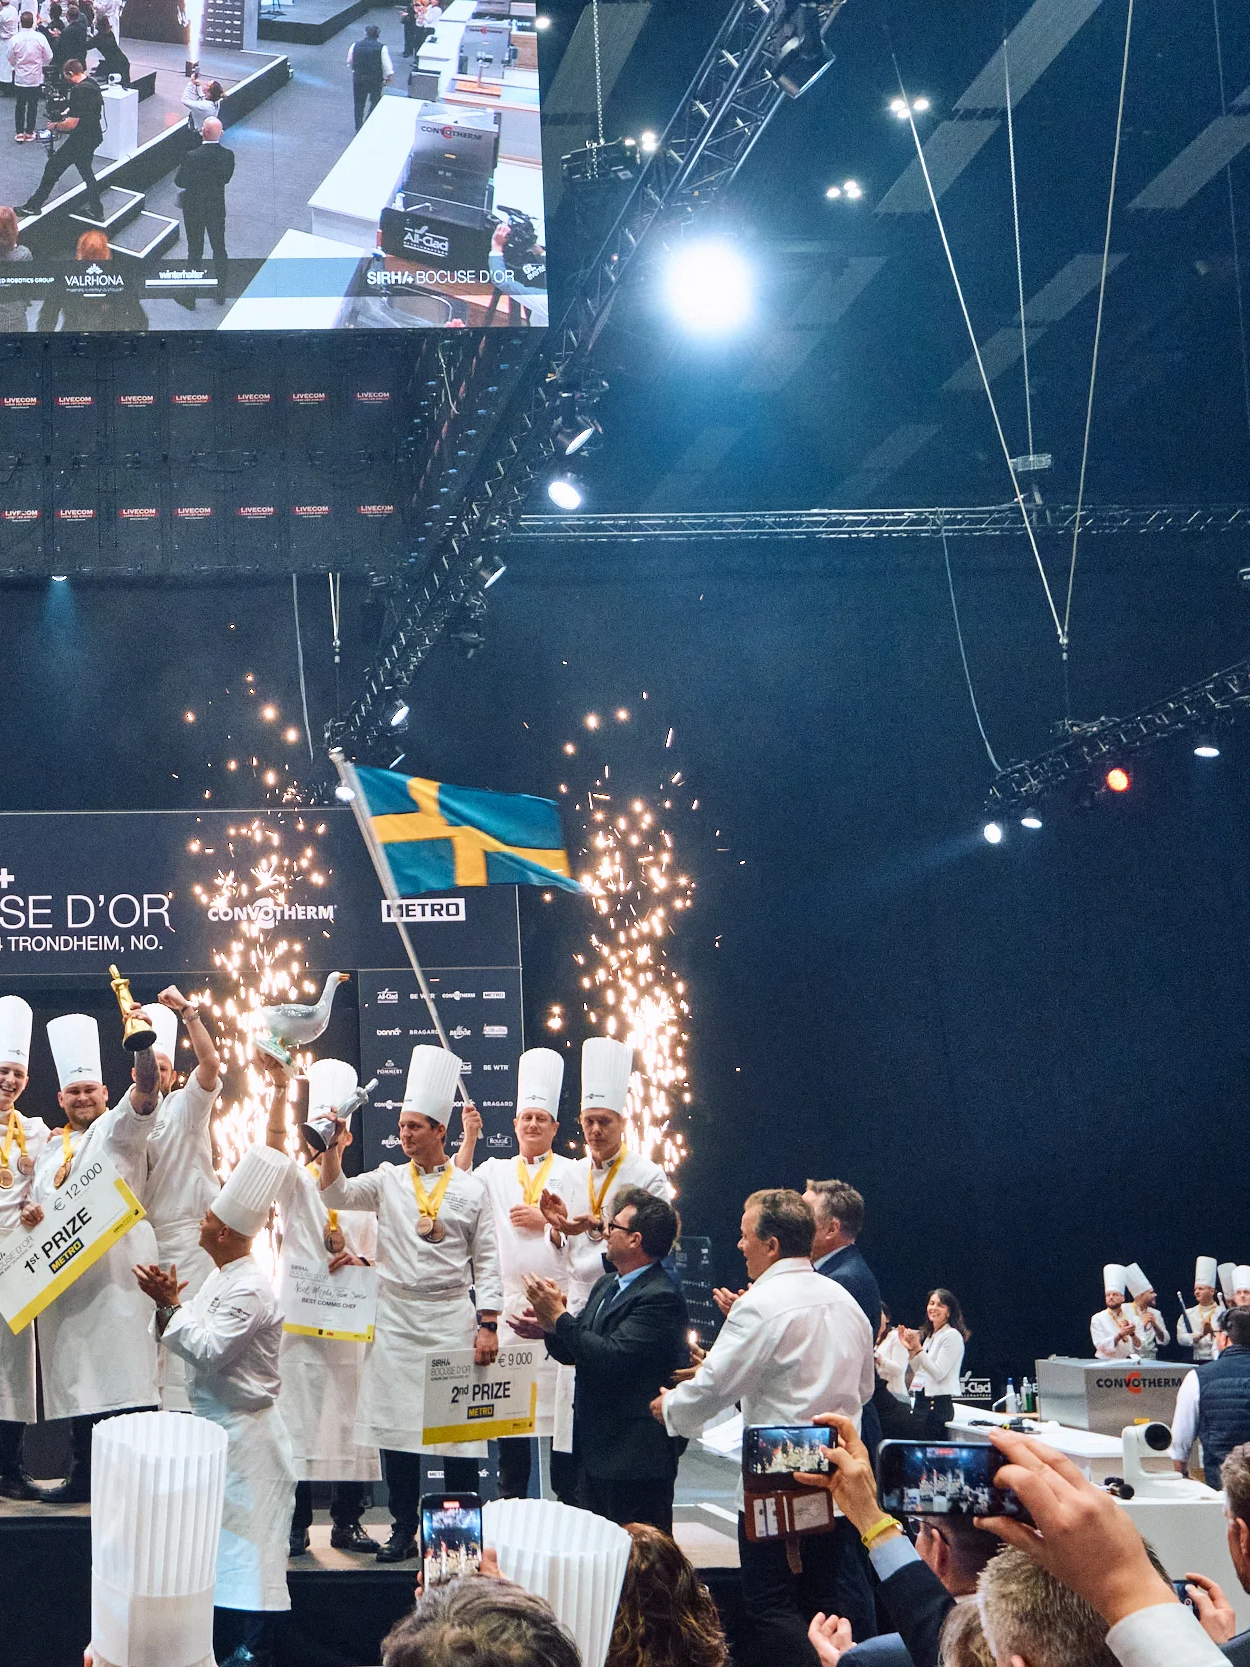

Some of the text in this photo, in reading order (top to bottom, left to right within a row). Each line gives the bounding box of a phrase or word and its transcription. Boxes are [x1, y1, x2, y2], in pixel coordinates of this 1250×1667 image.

[421, 126, 482, 140] CONVOTHERM
[65, 274, 124, 286] VALRHONA
[416, 271, 476, 284] BOCUSE
[480, 270, 515, 284] D'OR
[67, 893, 171, 928] D'OR
[207, 904, 334, 922] CONVOTHERM
[7, 935, 125, 953] TRONDHEIM,
[130, 934, 164, 950] NO.
[53, 1162, 103, 1212] € 12 000
[24, 1252, 40, 1274] 1st
[41, 1207, 92, 1258] PRIZE
[51, 1240, 82, 1271] METRO
[497, 1351, 533, 1368] € 9 000
[431, 1367, 456, 1377] BOCUSE
[1095, 1377, 1182, 1389] CONVOTHERM
[451, 1381, 511, 1403] 2nd PRIZE
[467, 1406, 493, 1417] METRO
